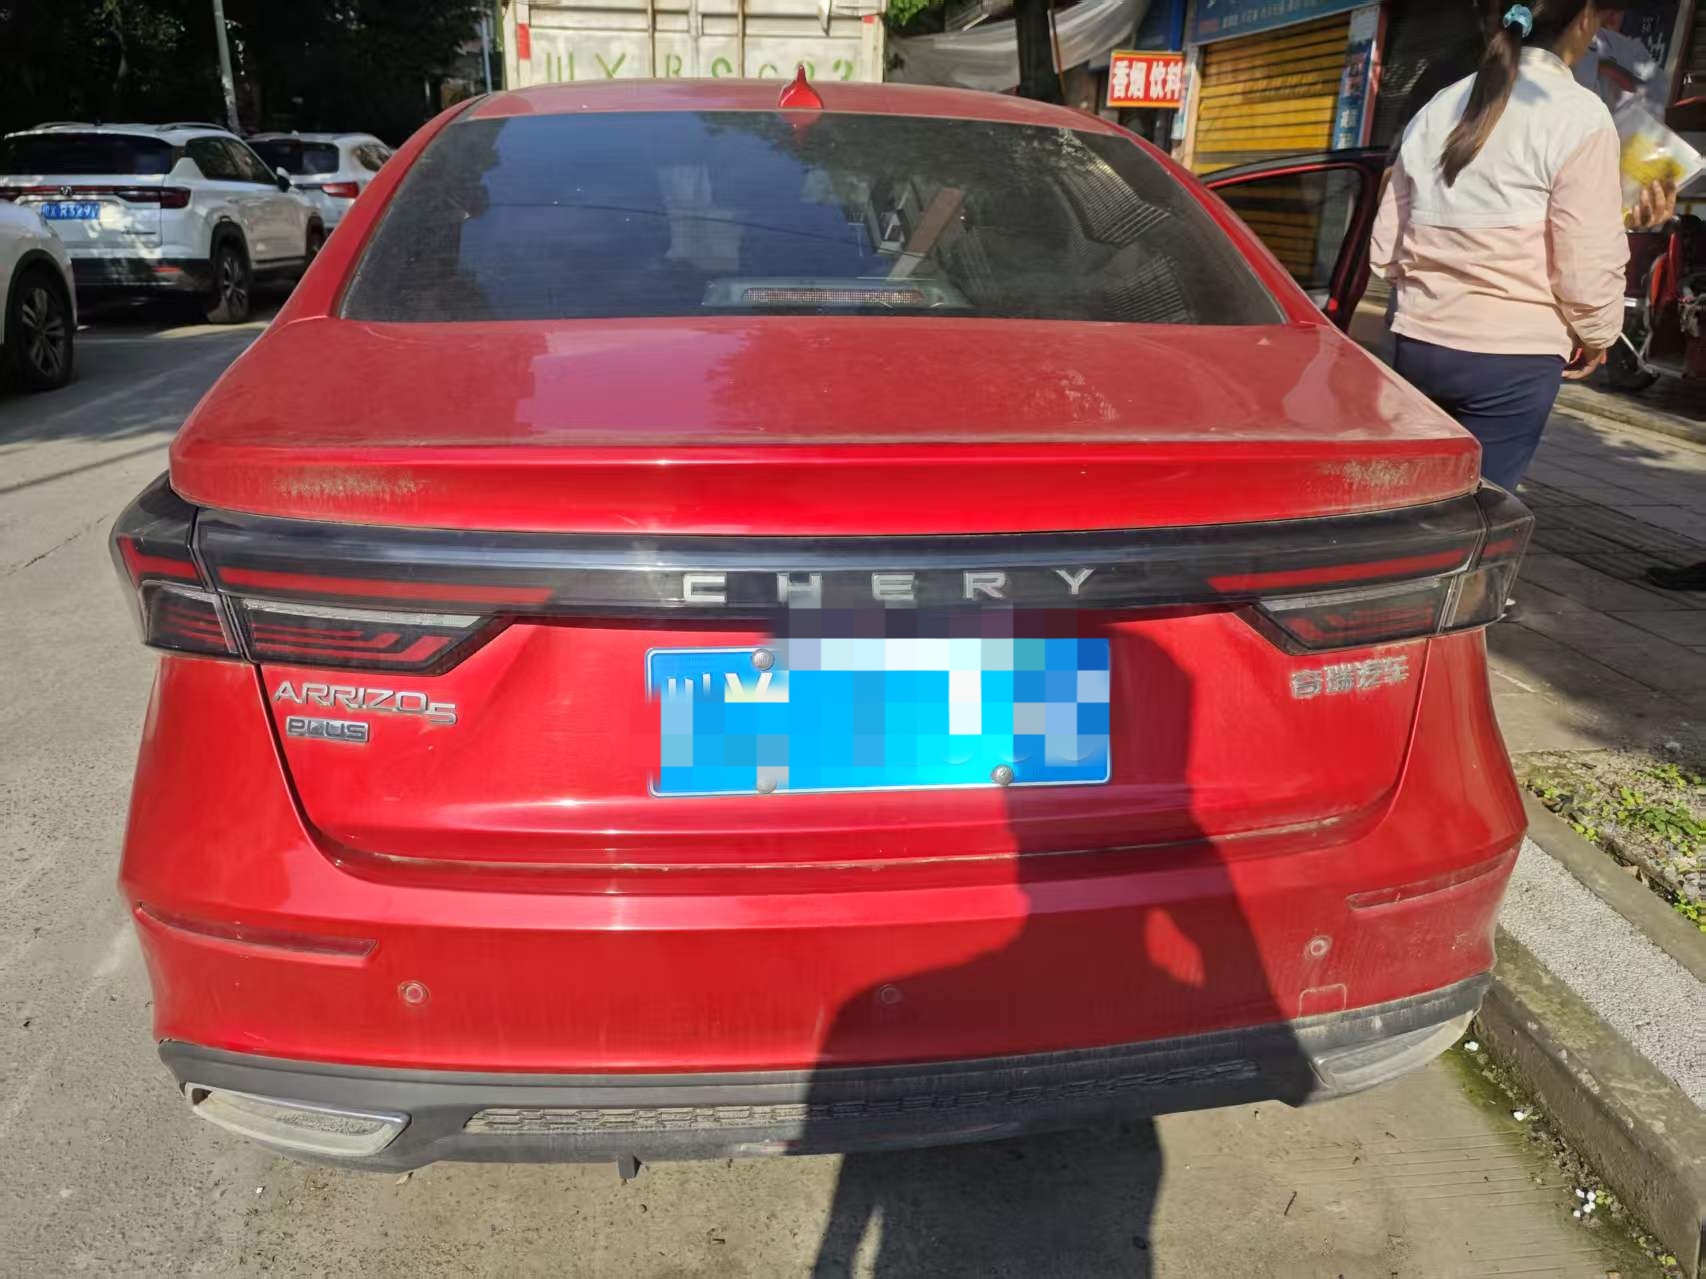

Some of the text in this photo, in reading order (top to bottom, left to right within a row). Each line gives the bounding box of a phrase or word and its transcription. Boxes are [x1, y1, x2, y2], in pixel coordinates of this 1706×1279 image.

[682, 568, 1095, 603] CHERY
[1291, 655, 1409, 699] 奇瑞汽车
[286, 716, 369, 743] PLUS
